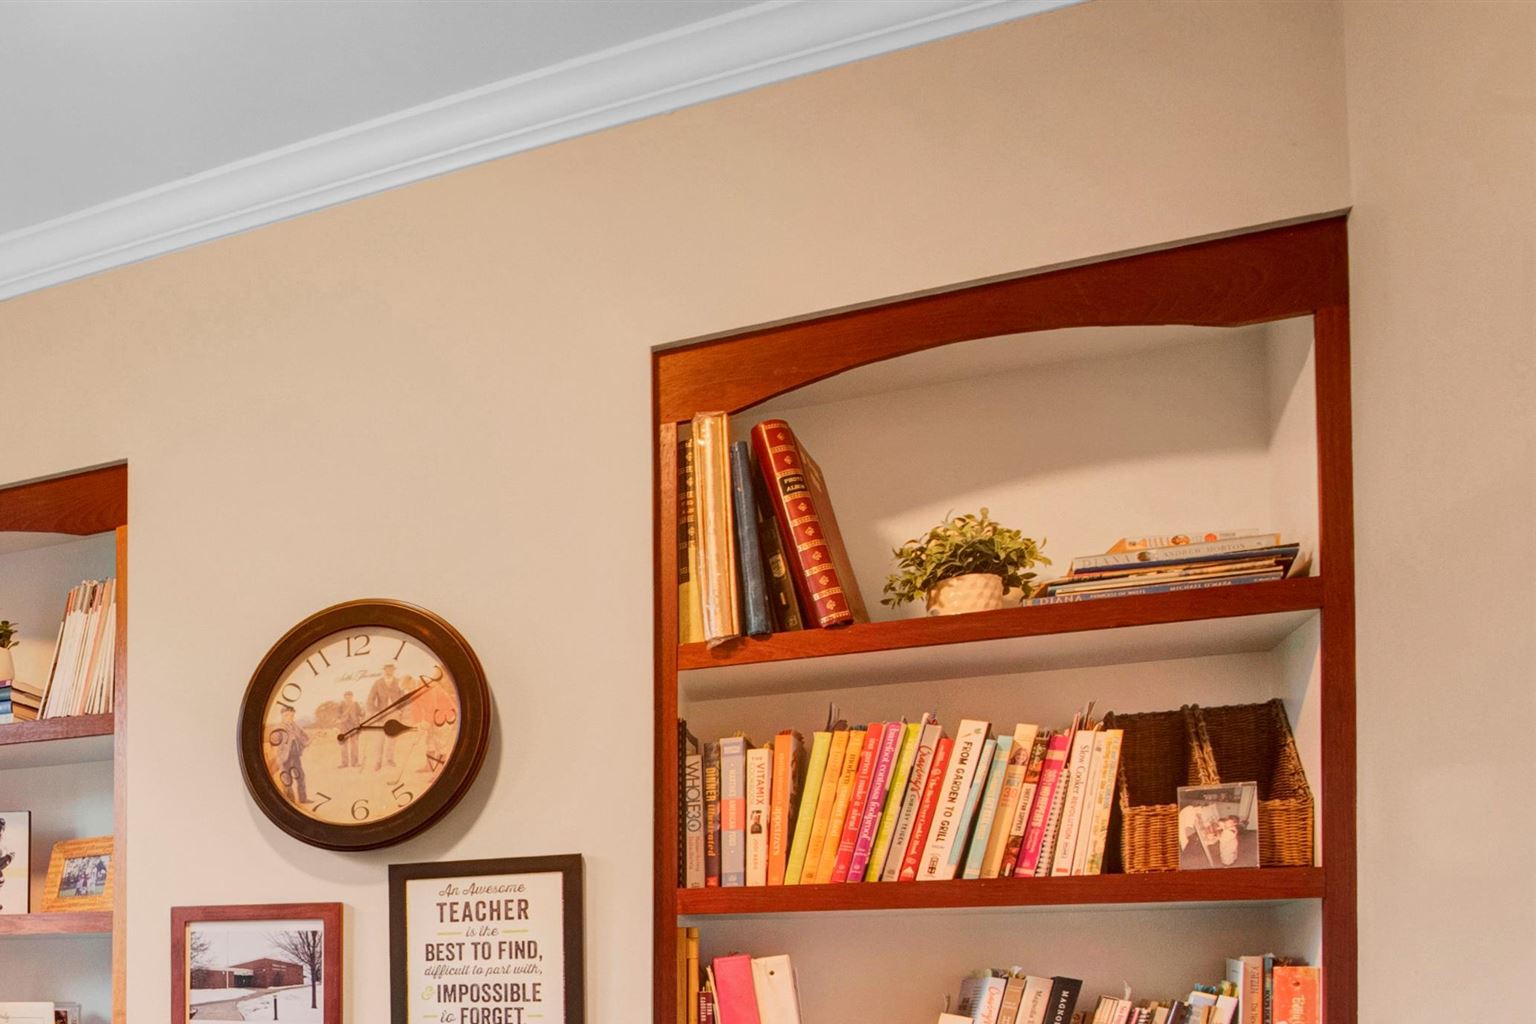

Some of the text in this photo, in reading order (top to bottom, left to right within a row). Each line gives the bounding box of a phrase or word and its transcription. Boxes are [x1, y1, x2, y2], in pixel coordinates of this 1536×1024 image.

[1038, 593, 1082, 606] DIANA
[345, 634, 371, 658] 12
[393, 640, 407, 660] 1
[306, 650, 331, 676] 11
[276, 683, 302, 711] 10
[433, 708, 456, 727] 3
[269, 728, 289, 747] 9
[881, 728, 898, 763] barefoot
[426, 752, 445, 772] 4
[1077, 743, 1090, 764] Slow
[280, 766, 301, 787] 8
[705, 767, 716, 800] DINNER
[756, 763, 764, 804] VITAMIX
[871, 763, 887, 800] contessa
[1072, 764, 1086, 793] Cooker
[311, 792, 332, 812] 7
[391, 783, 414, 808] 5
[686, 761, 700, 831] WHOLE30
[934, 739, 973, 844] FROM GARDEN TO GRILL
[351, 799, 370, 821] 6
[858, 799, 879, 839] foolproof
[438, 882, 526, 897] An Awesome
[436, 898, 530, 923] TEACHER
[465, 925, 499, 937] is the
[425, 940, 543, 962] BEST TO FIND,
[424, 965, 469, 979] difficult
[471, 965, 483, 976] to
[485, 964, 511, 977] part
[436, 983, 542, 1003] IMPOSSIBLE
[1031, 990, 1044, 1023] Magnolia
